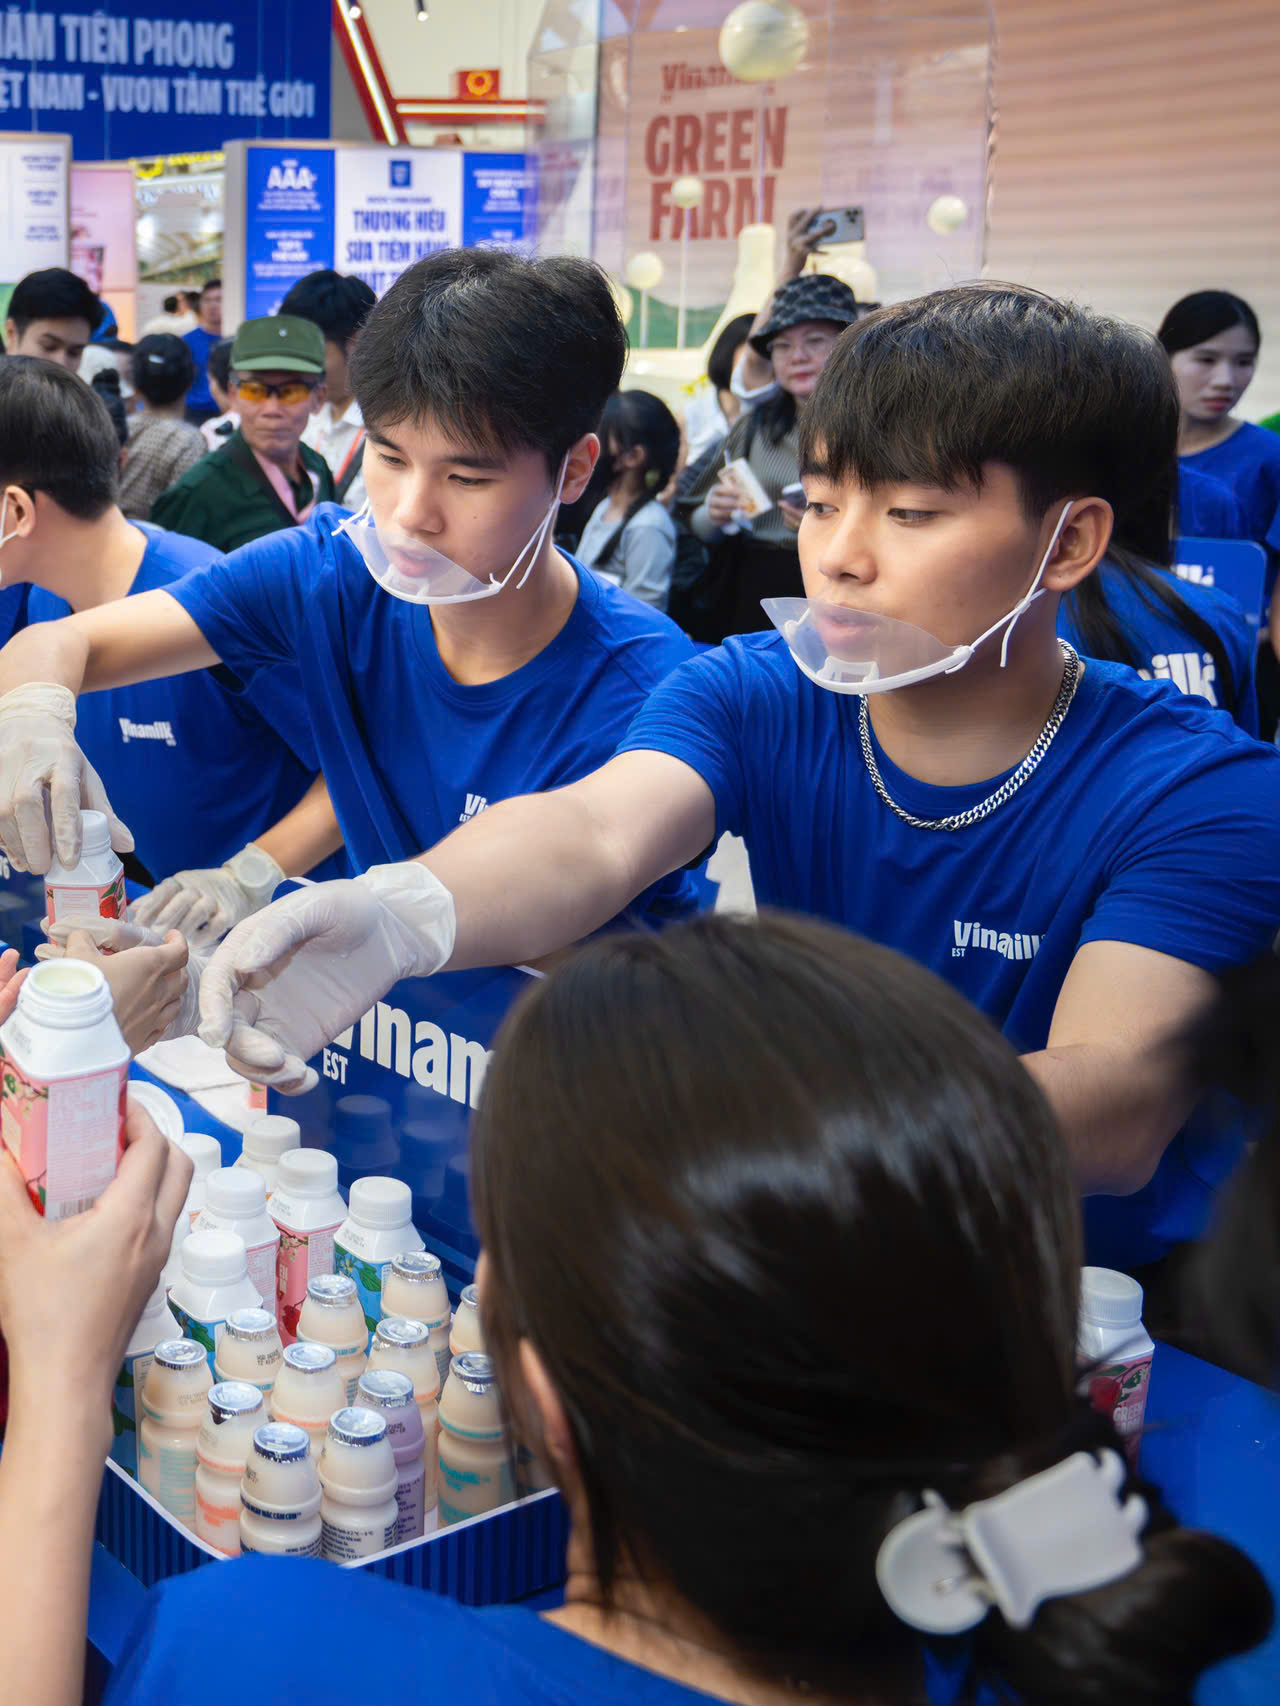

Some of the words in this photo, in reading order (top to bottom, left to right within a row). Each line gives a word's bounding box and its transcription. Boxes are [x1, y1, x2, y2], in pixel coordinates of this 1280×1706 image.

[134, 20, 234, 69] PHONG
[27, 72, 85, 110] NAM
[644, 106, 788, 176] GREEN
[951, 947, 966, 958] EST
[322, 1048, 348, 1085] EST
